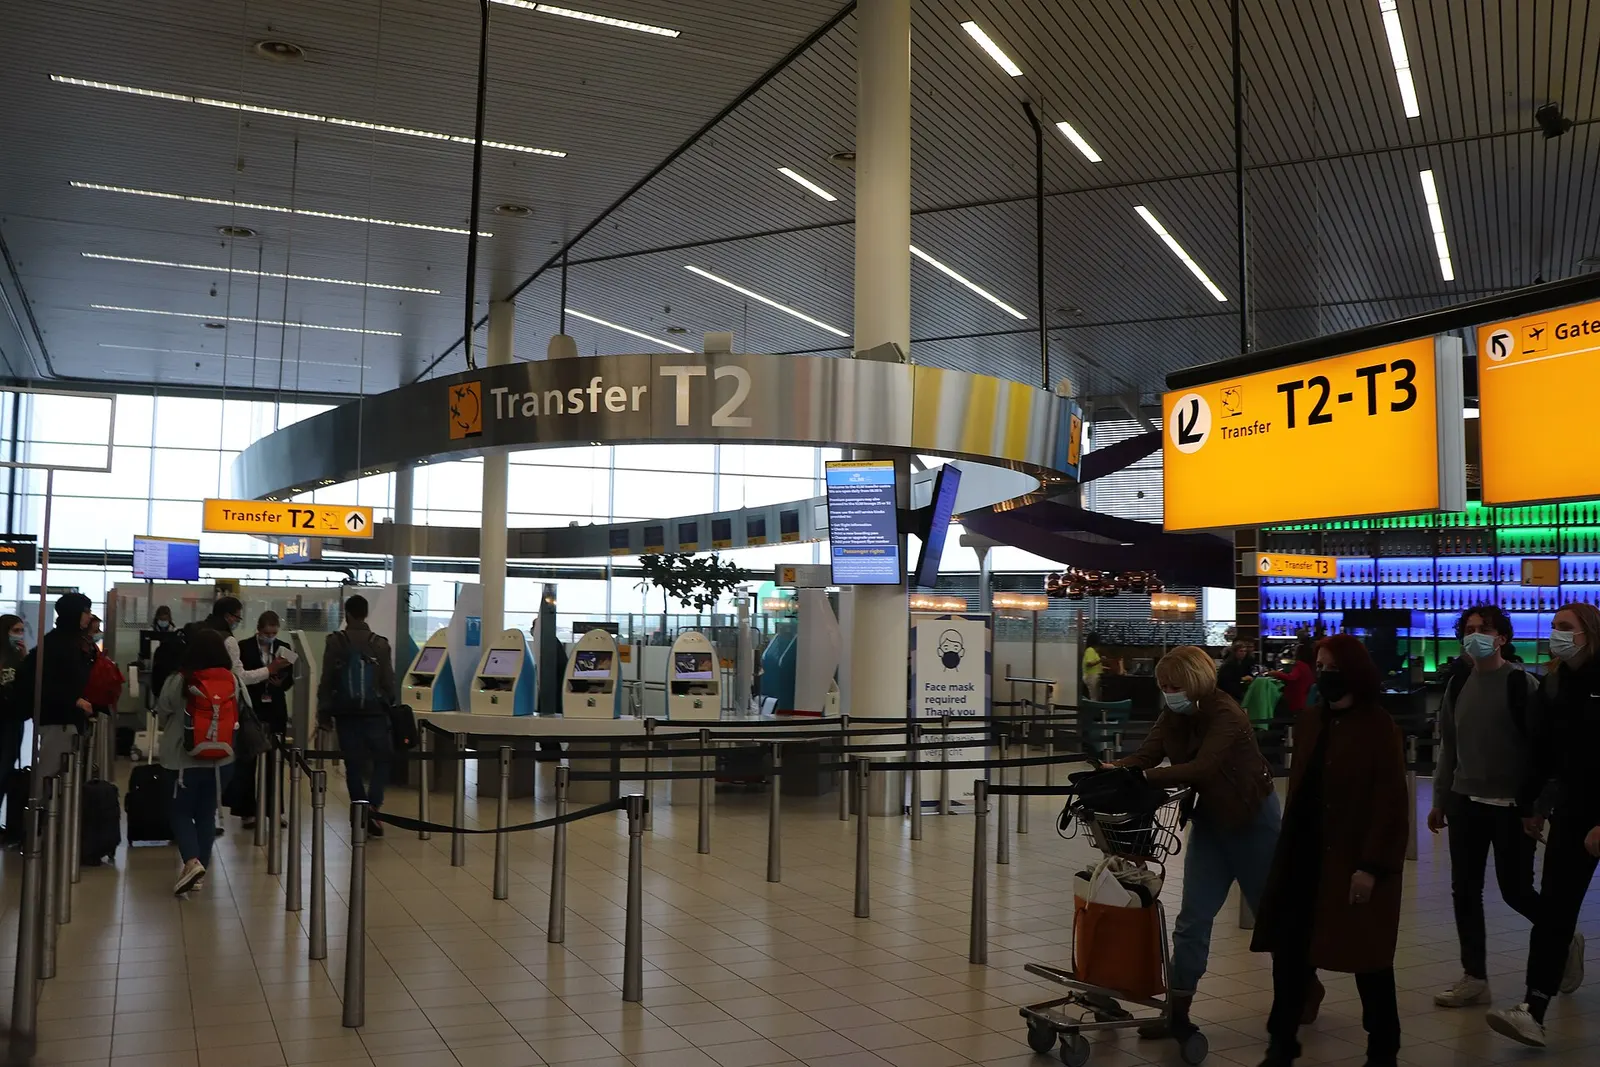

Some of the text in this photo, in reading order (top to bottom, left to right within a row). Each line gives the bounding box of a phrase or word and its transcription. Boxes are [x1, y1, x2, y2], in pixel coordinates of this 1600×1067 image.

[490, 365, 753, 427] Transfer T2
[1277, 358, 1418, 429] T2-T3
[1221, 420, 1272, 440] Transfer
[222, 509, 315, 529] Transfer T2
[1284, 560, 1328, 574] Transfer T3
[925, 683, 975, 691] Face mask
[925, 695, 967, 705] required
[925, 708, 955, 716] Thank
